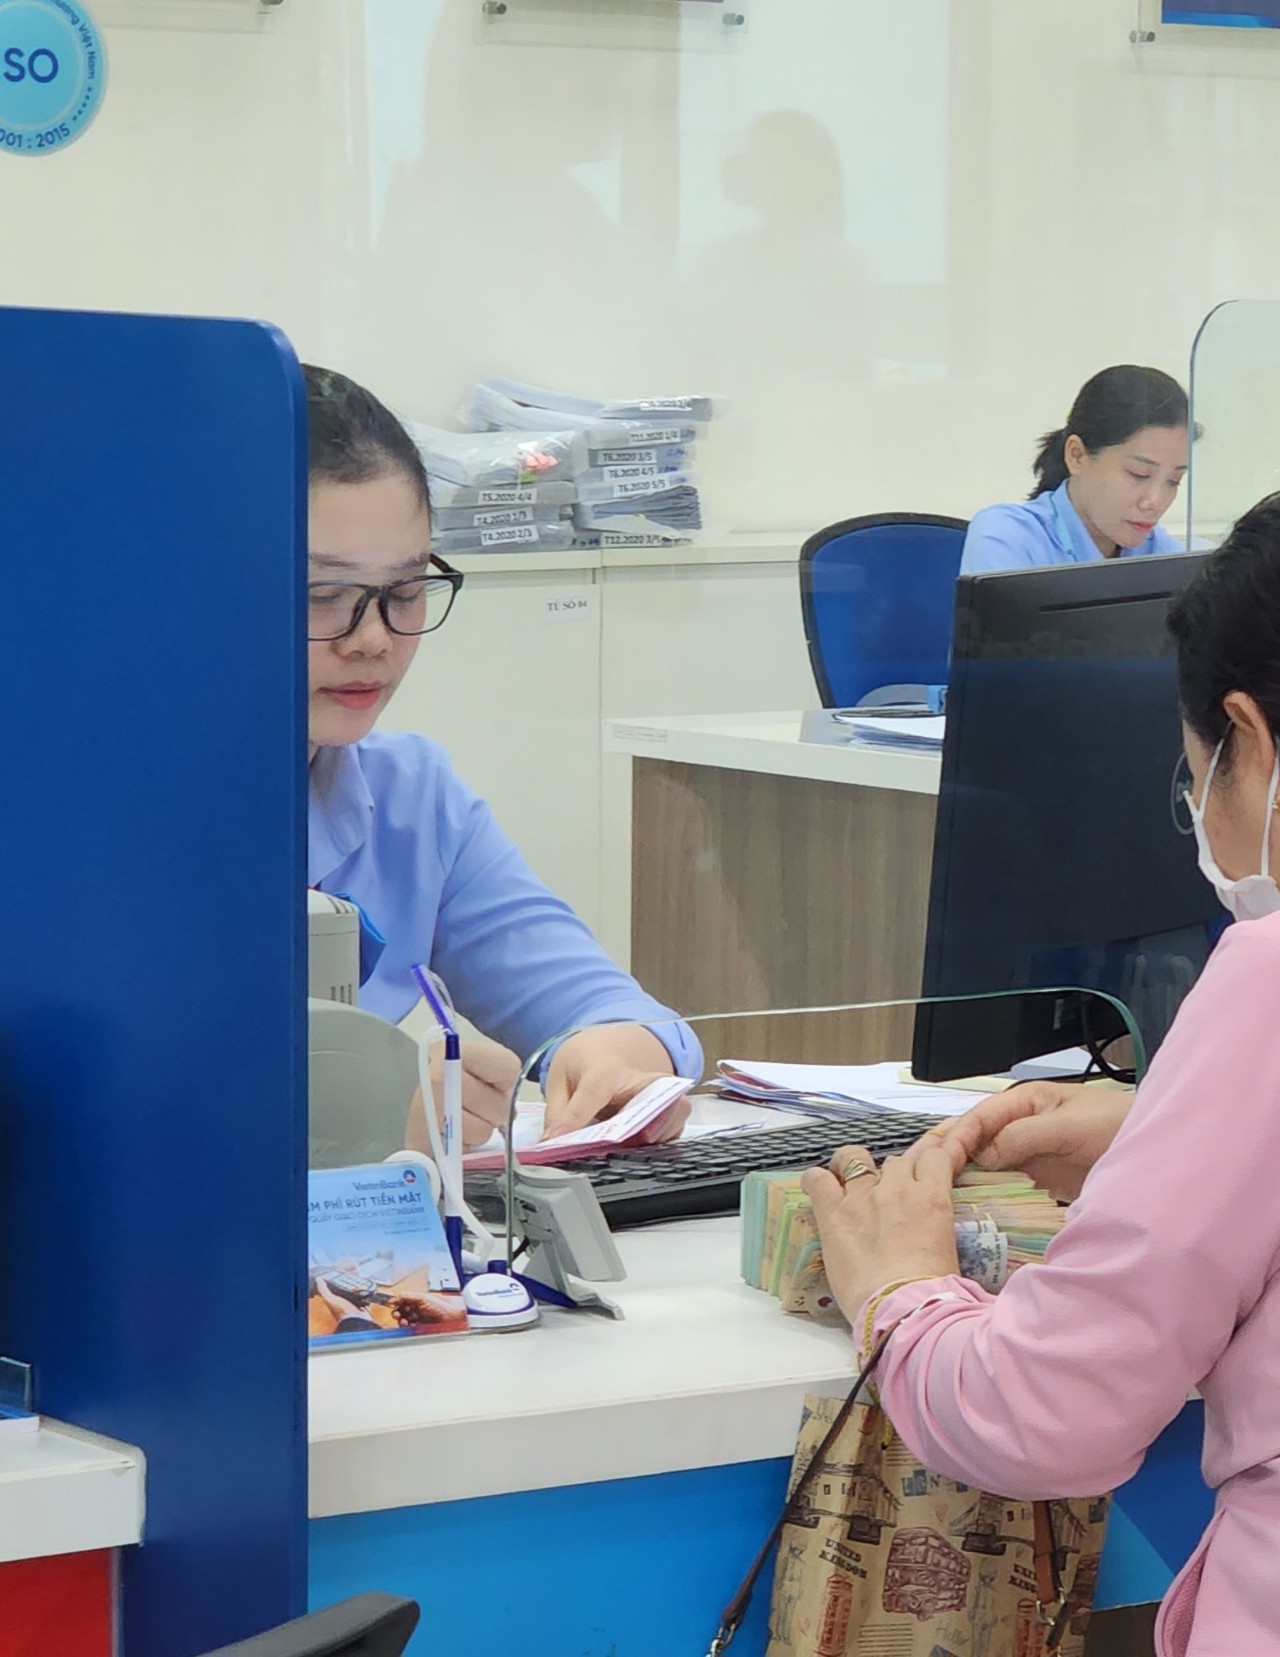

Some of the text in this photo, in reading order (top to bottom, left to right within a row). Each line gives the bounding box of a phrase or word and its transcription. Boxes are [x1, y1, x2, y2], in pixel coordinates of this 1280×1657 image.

[3, 48, 59, 83] SO
[36, 123, 70, 147] 2015
[352, 1179, 405, 1191] VietinBank
[324, 1198, 343, 1210] PHÍ
[346, 1195, 367, 1208] RÚT
[398, 1190, 422, 1207] MẶT
